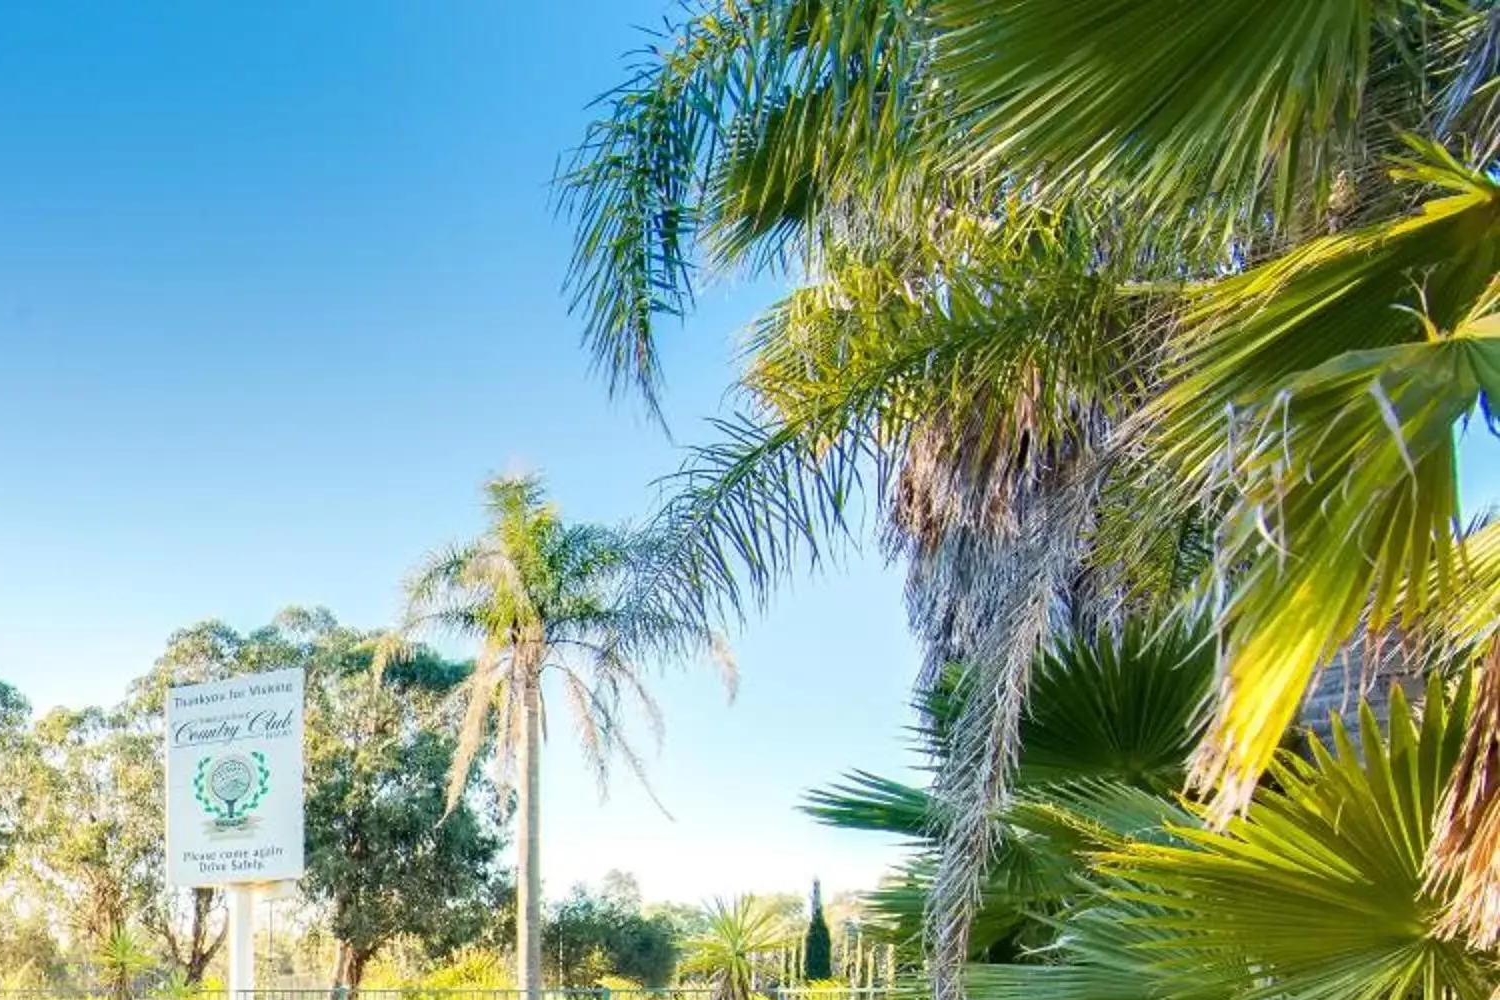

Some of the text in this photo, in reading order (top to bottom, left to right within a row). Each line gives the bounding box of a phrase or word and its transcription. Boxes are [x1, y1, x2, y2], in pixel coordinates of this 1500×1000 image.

[229, 689, 245, 699] for
[173, 720, 240, 745] Country
[247, 708, 294, 732] Club
[183, 845, 283, 862] Please come again
[199, 862, 226, 872] Drive
